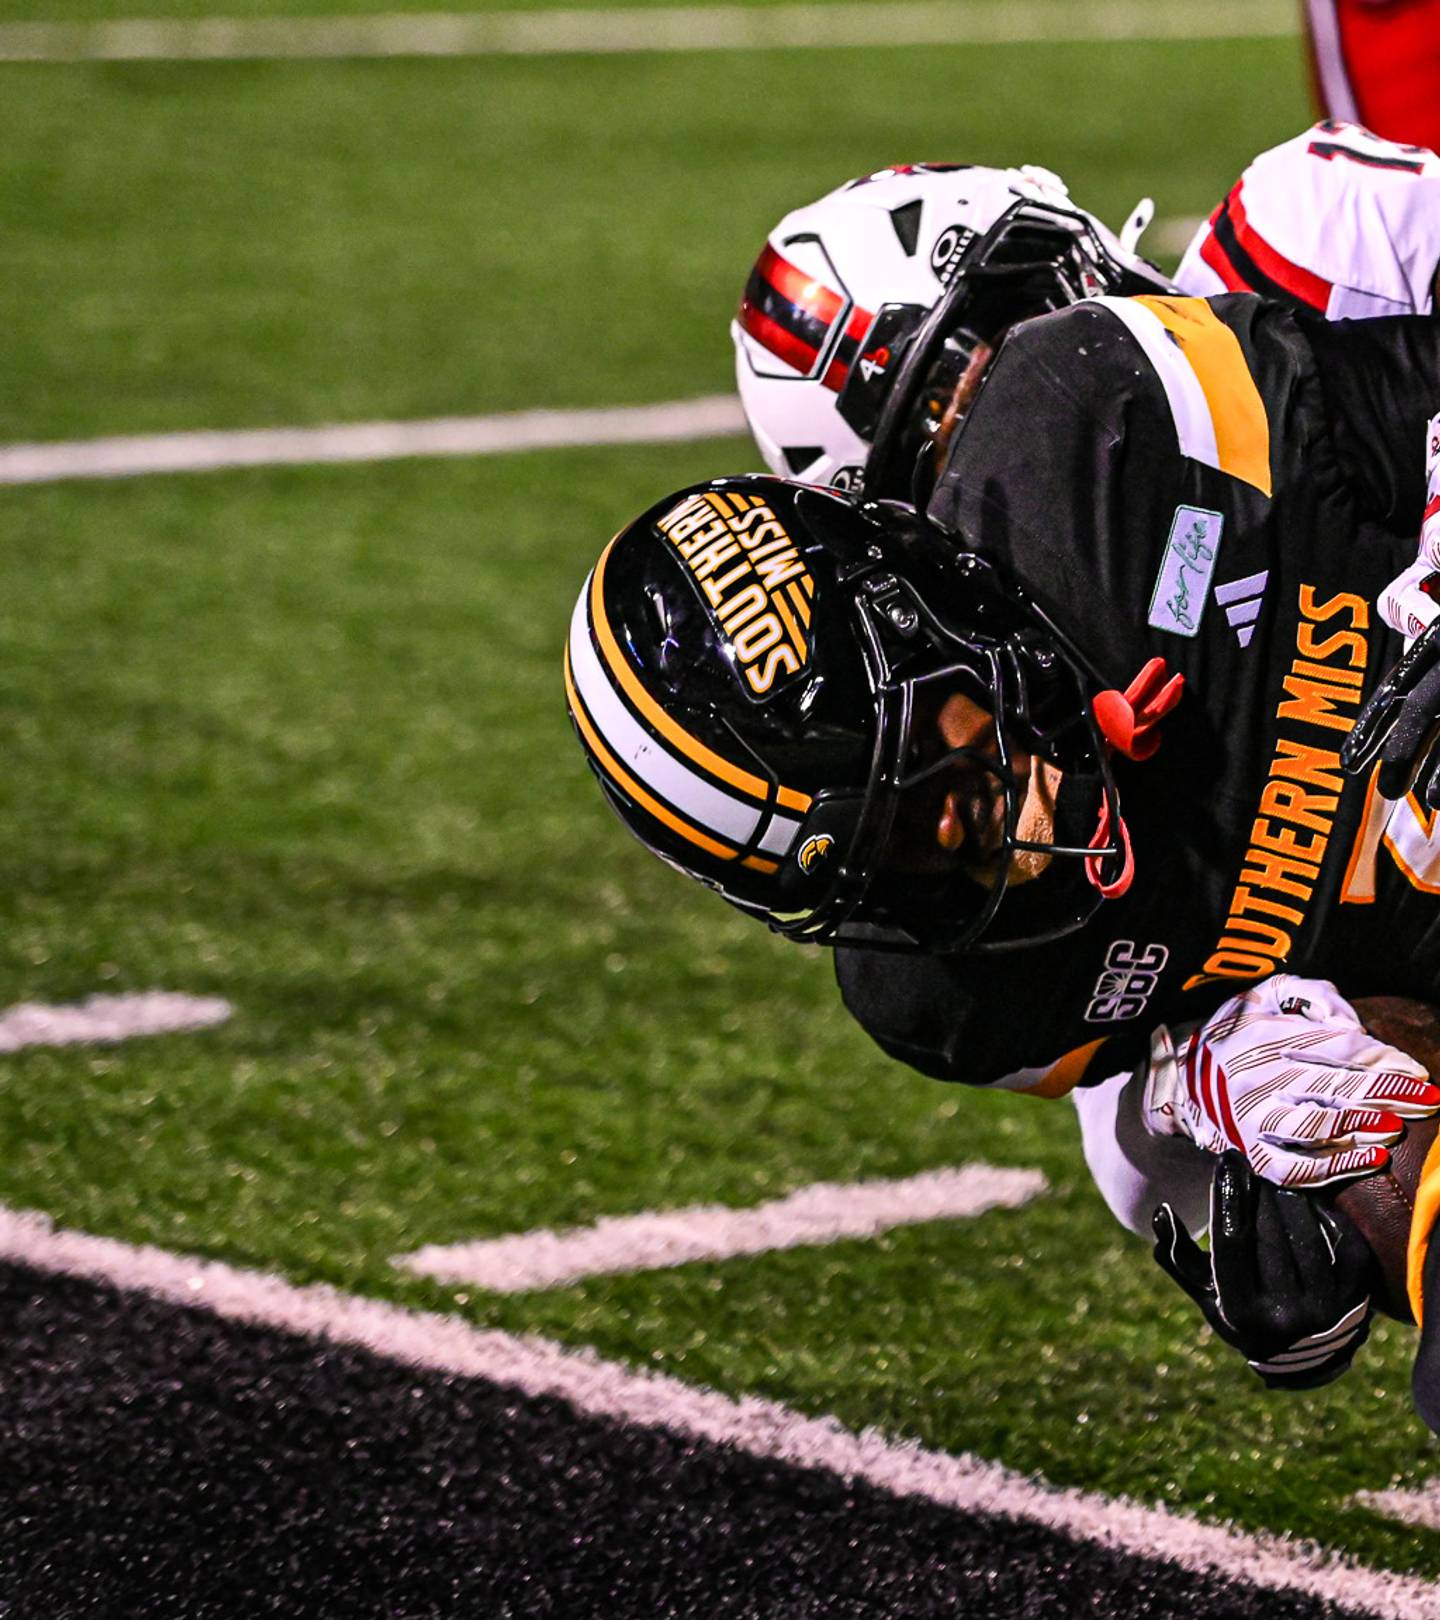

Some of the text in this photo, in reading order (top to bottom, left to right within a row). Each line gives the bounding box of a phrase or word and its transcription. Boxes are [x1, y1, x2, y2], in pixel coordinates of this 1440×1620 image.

[656, 493, 801, 694] SOUTHERN
[725, 505, 806, 593] MISS
[1182, 583, 1371, 991] OUTHERN MISS
[1084, 940, 1169, 1022] SBC
